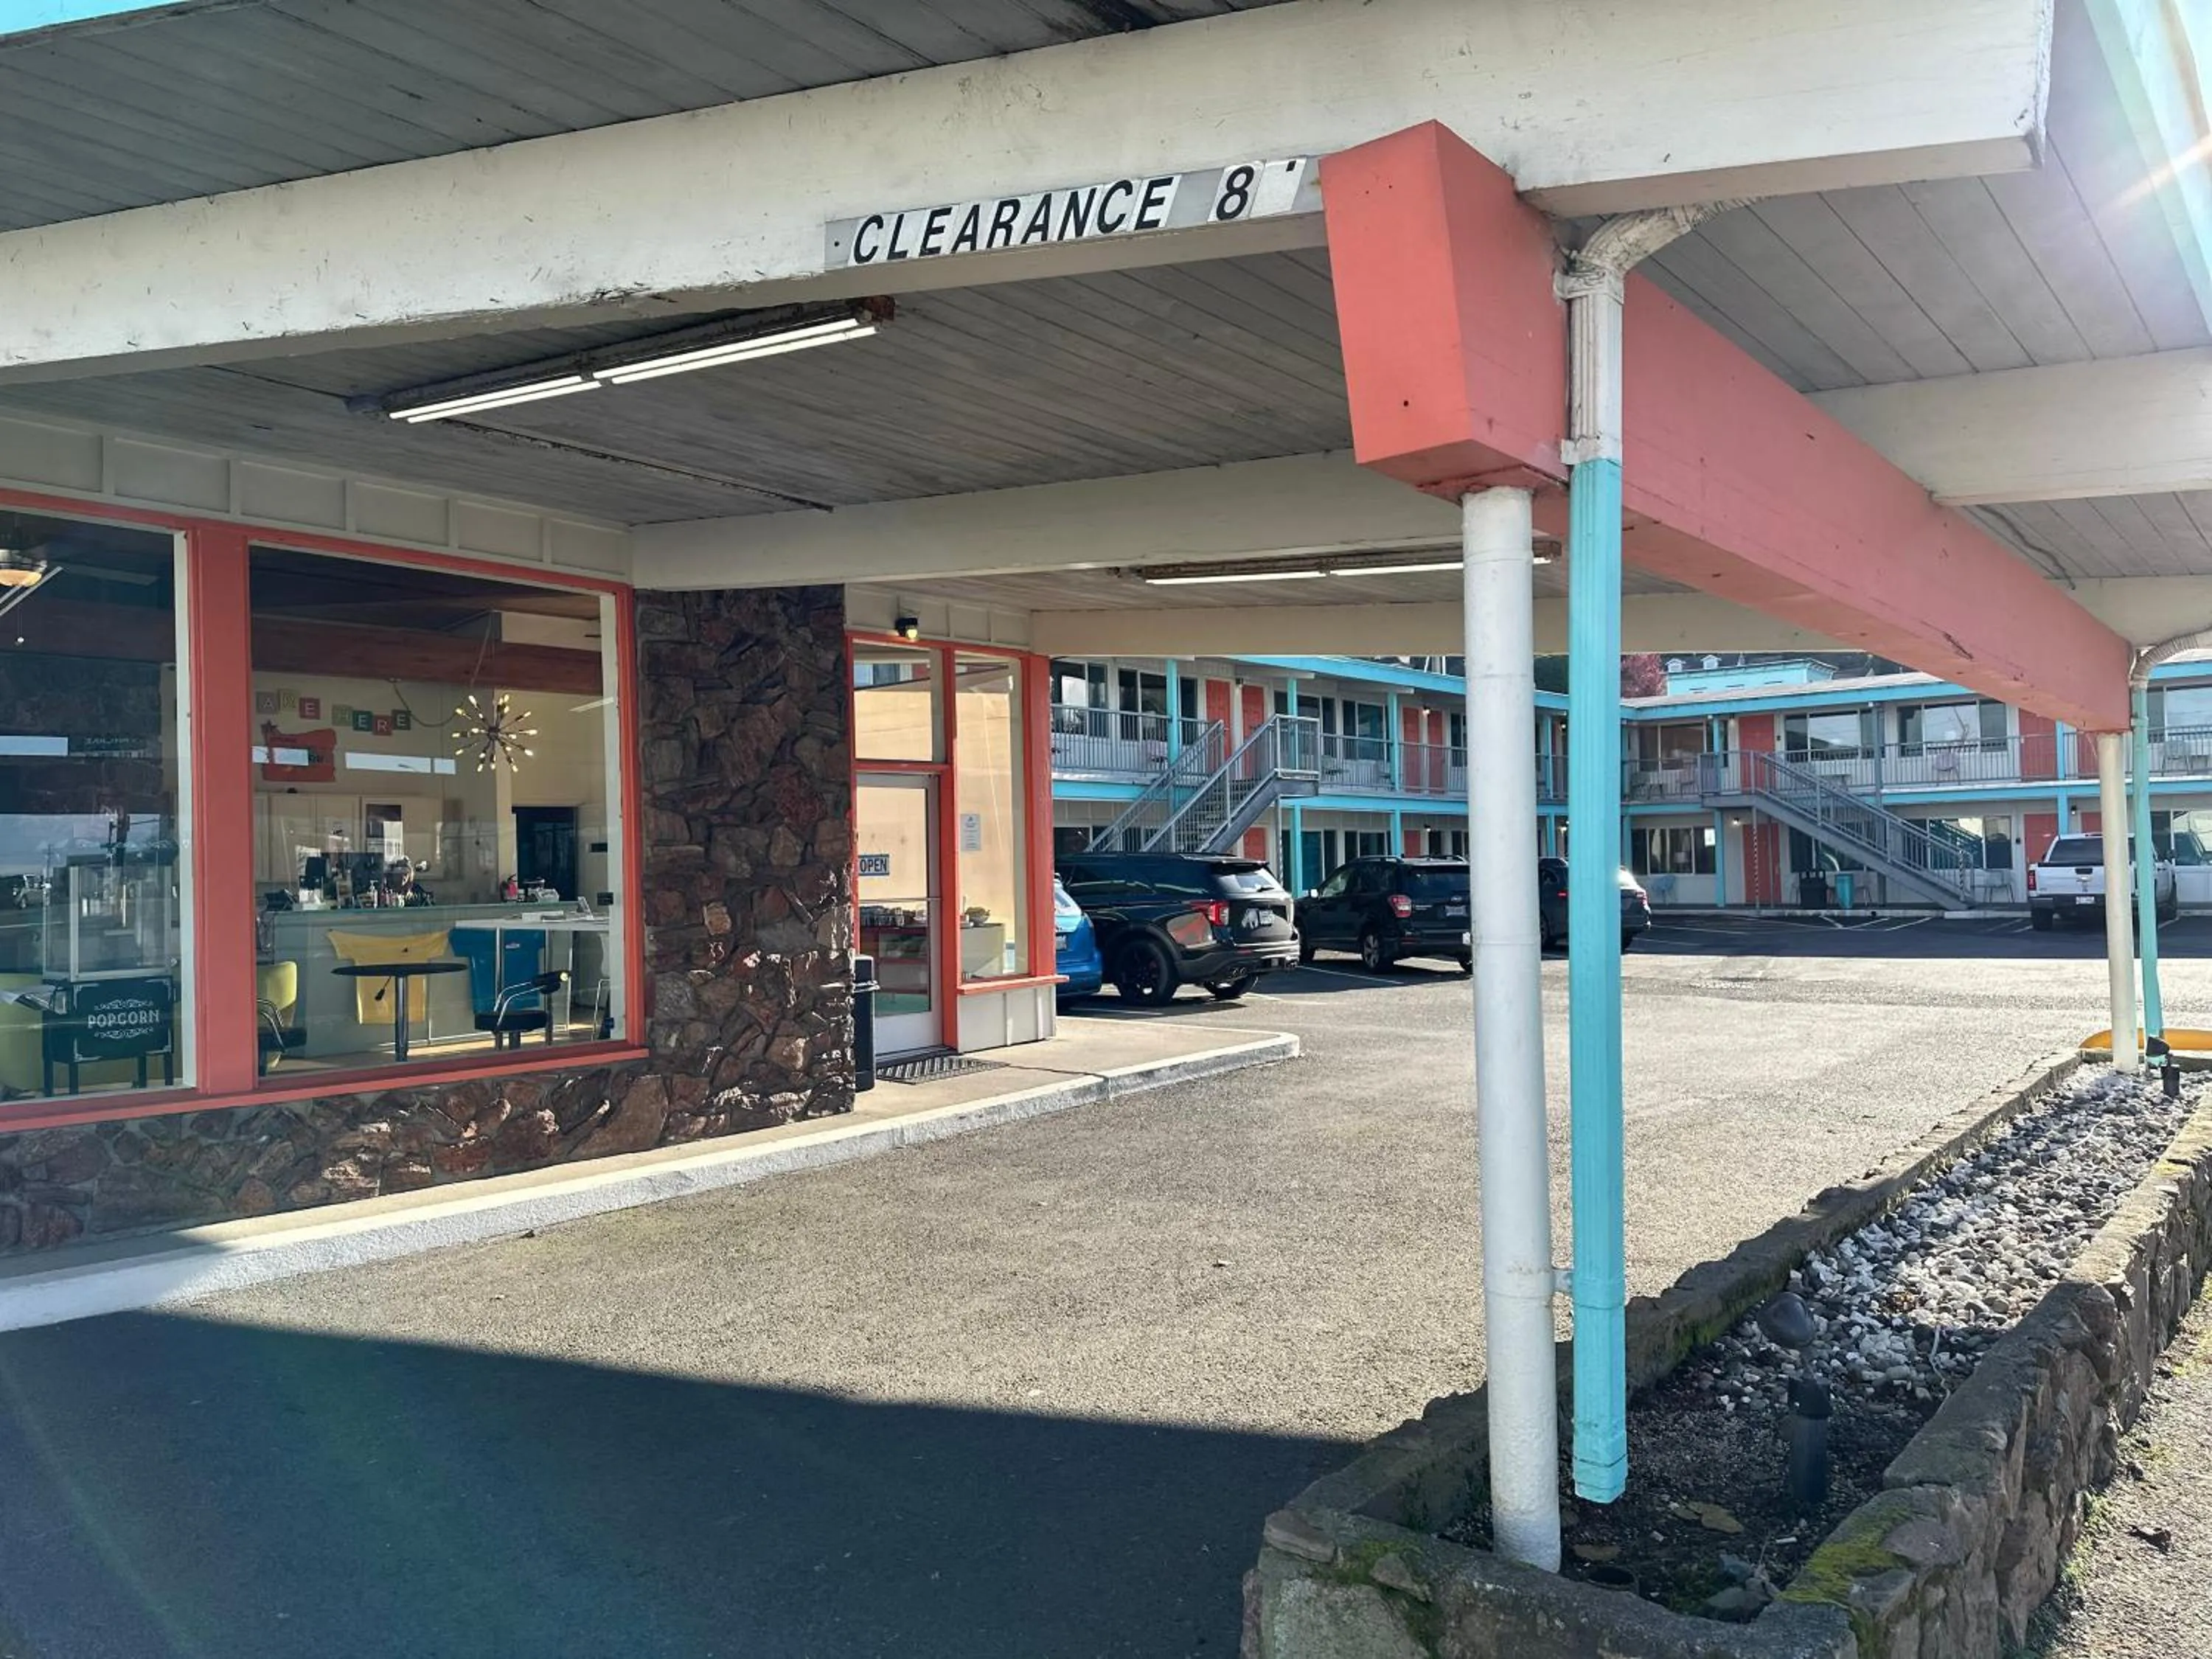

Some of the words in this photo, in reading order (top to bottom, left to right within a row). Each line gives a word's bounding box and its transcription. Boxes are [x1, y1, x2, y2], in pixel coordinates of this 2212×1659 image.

[854, 176, 1174, 264] CLEARANCE
[859, 858, 887, 872] OPEN
[88, 1009, 159, 1029] POPCORN
